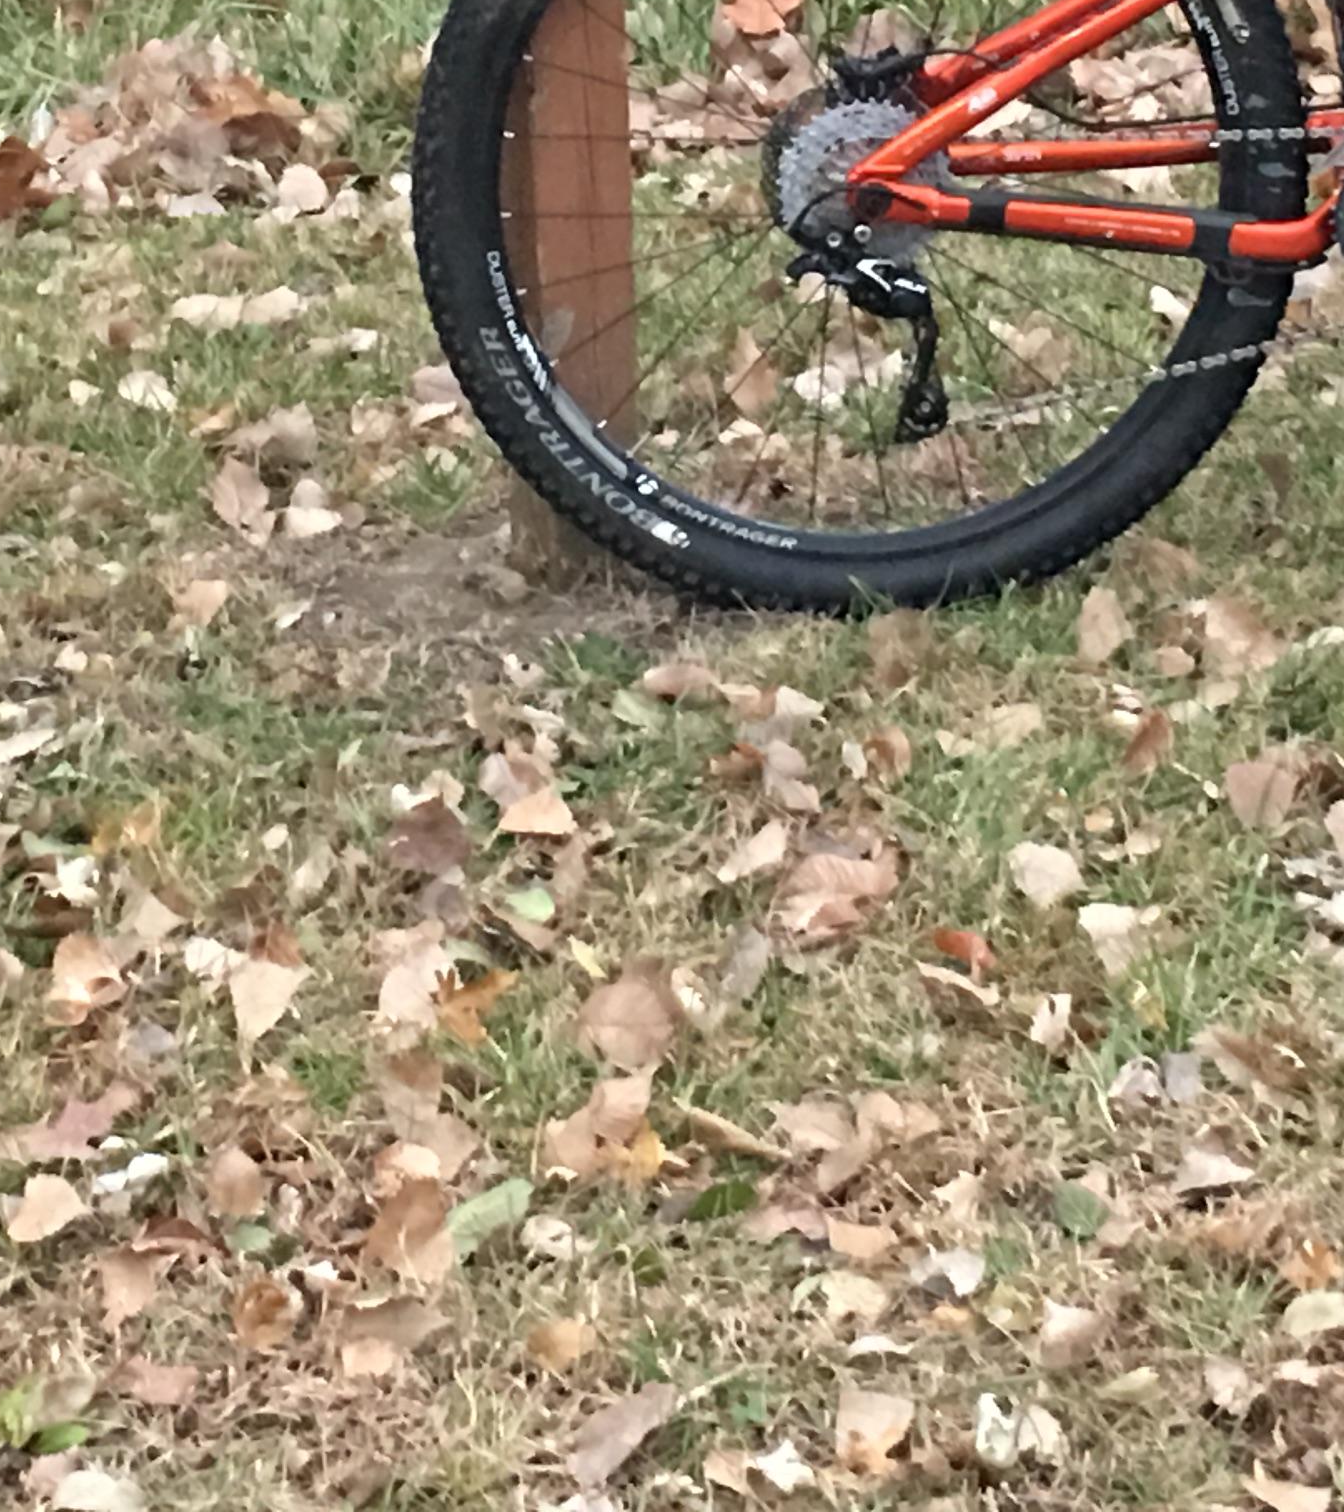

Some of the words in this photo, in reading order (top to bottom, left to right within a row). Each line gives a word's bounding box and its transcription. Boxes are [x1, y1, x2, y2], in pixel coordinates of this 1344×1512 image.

[486, 251, 515, 319] DUSTER
[478, 326, 662, 532] BONTRAGER
[660, 494, 798, 550] BONTRAGER
